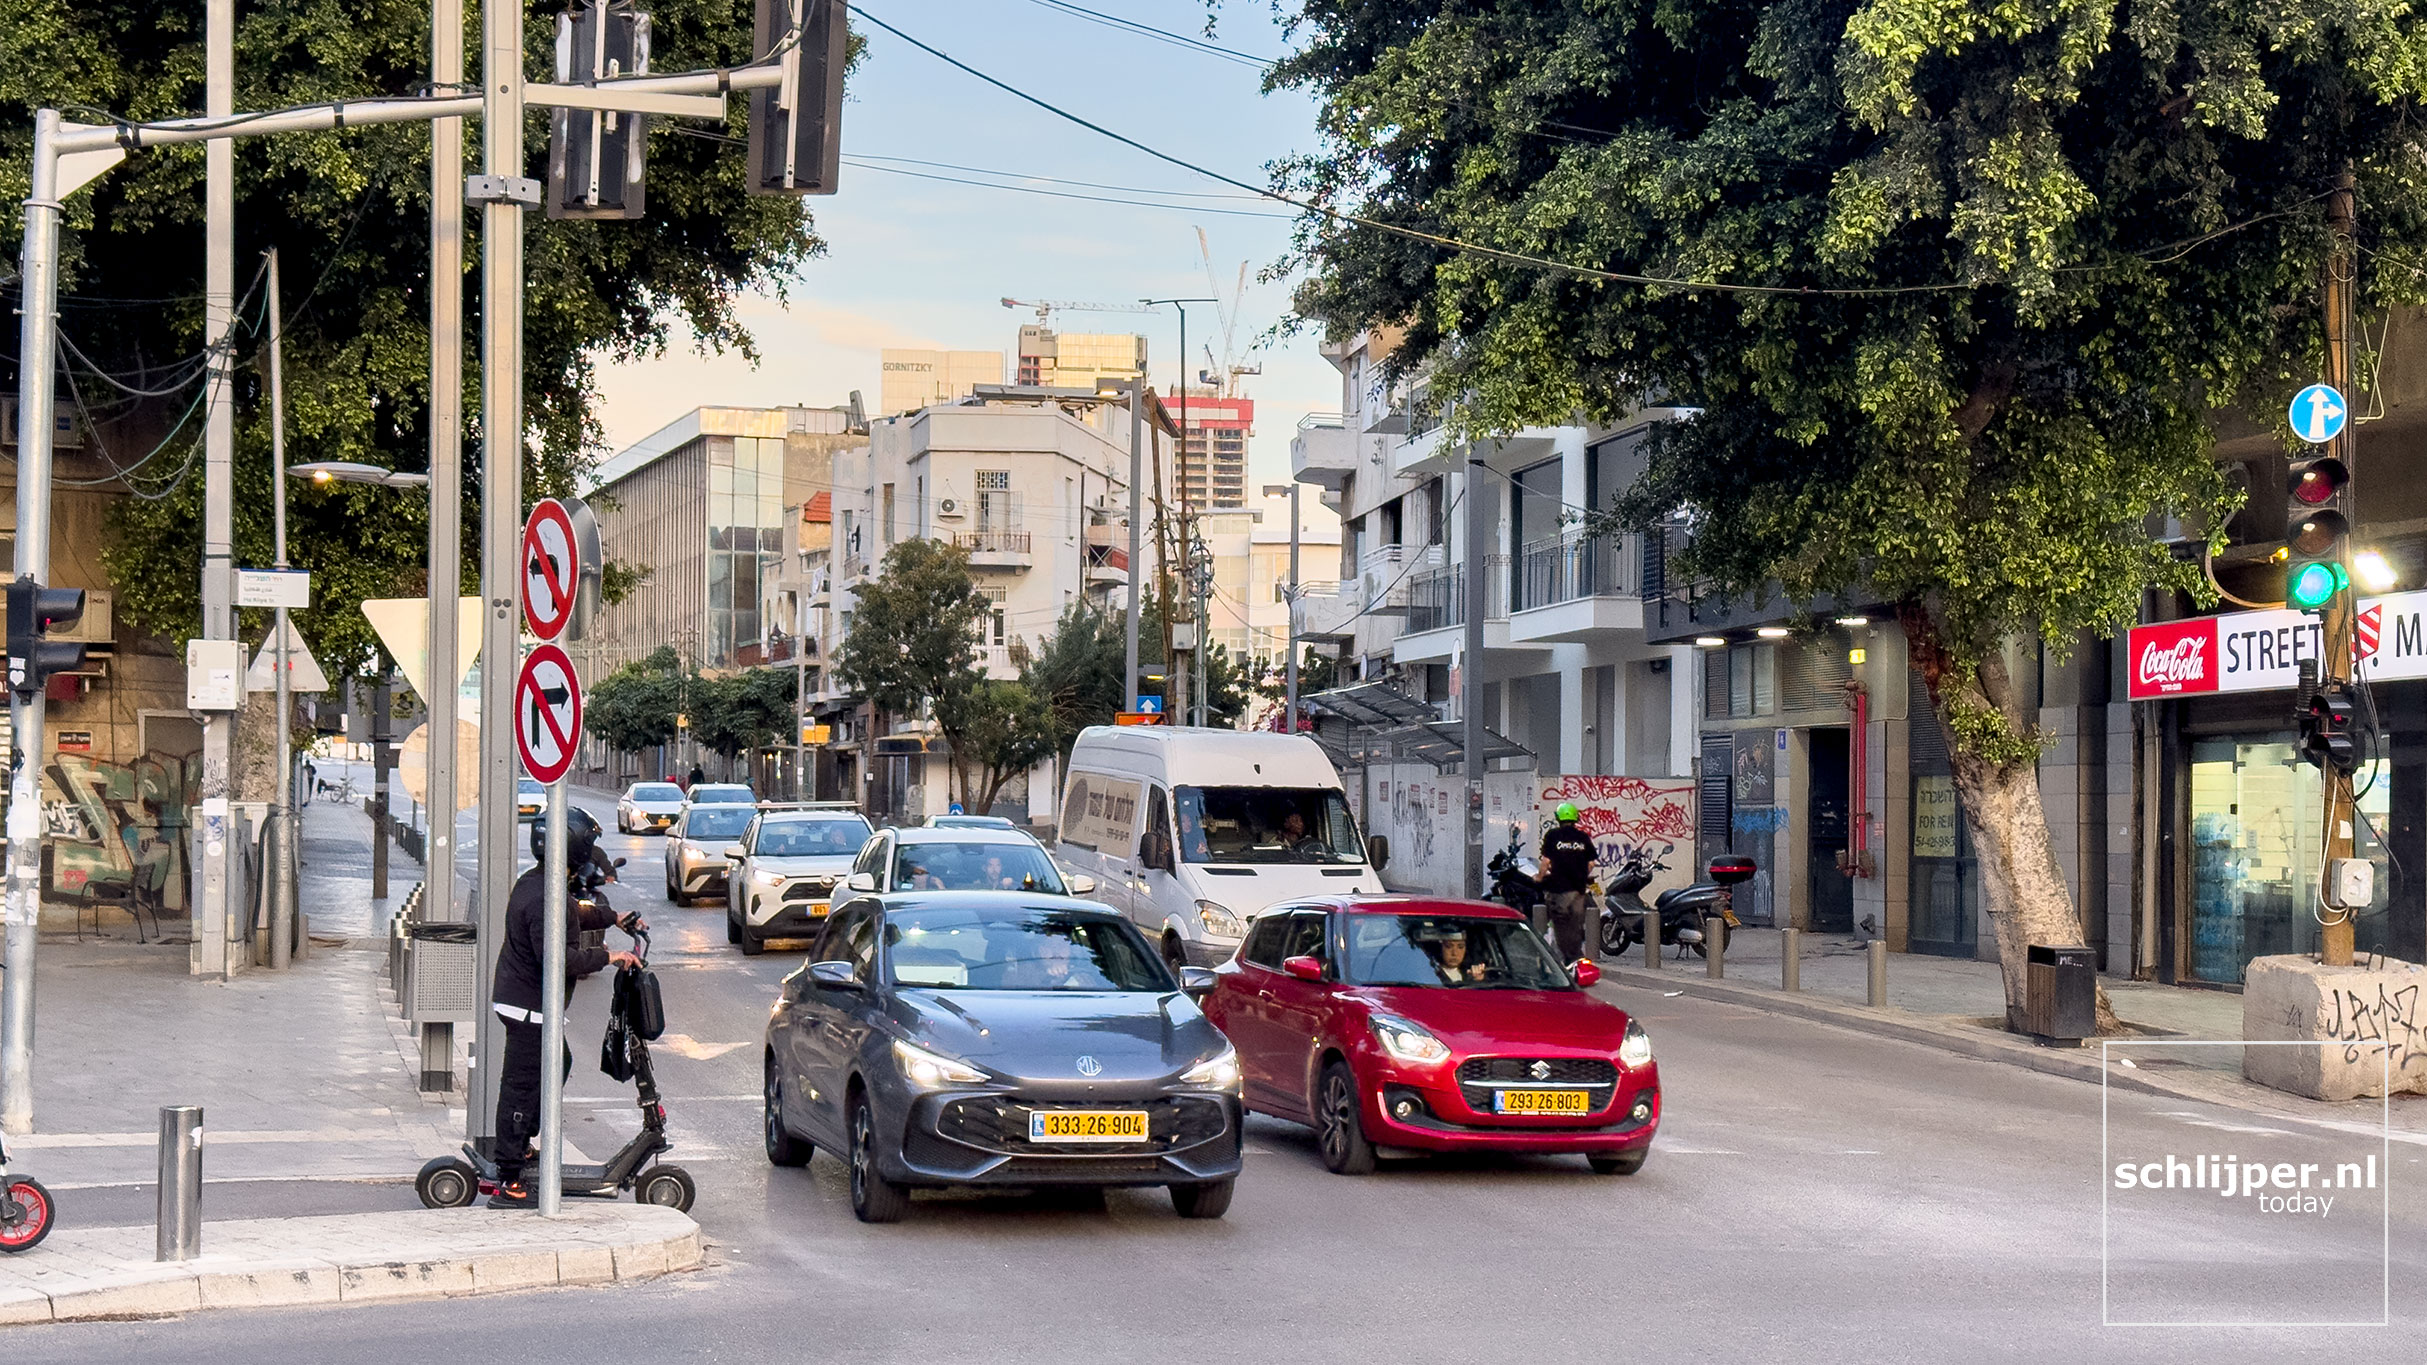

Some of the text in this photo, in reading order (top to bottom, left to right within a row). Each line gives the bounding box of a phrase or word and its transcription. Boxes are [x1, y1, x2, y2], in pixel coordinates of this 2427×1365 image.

[883, 362, 932, 372] GORNITZKY
[2227, 613, 2427, 673] STREET M
[2140, 636, 2206, 684] Coca-Cola
[1919, 815, 1936, 829] FOR
